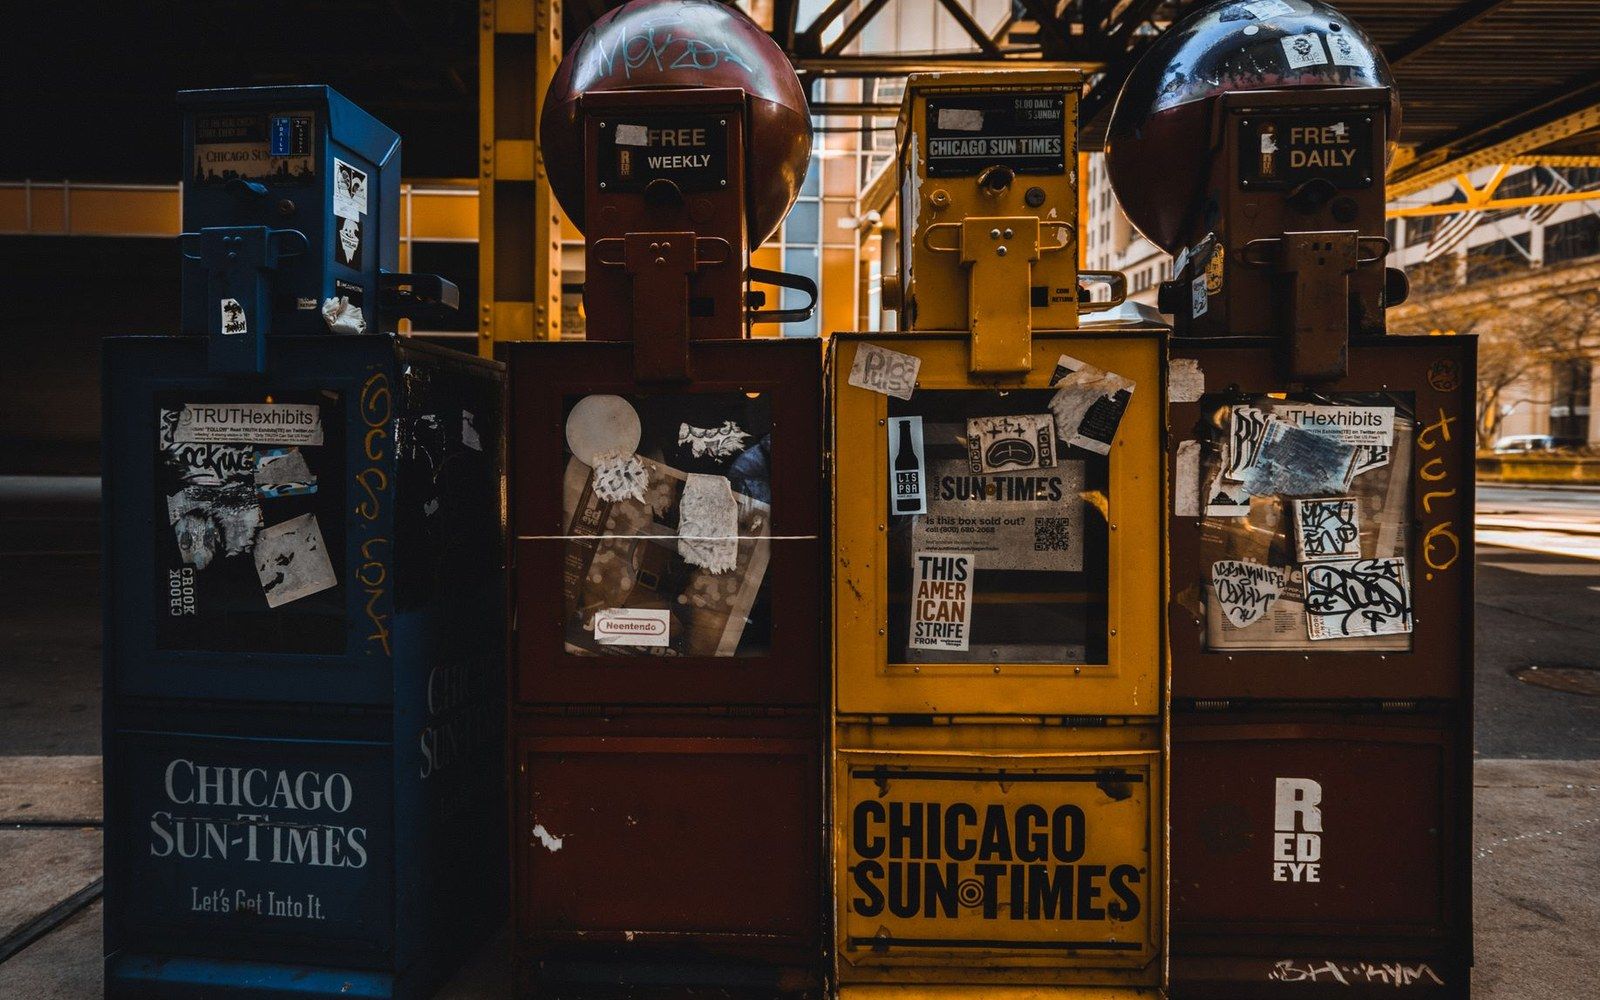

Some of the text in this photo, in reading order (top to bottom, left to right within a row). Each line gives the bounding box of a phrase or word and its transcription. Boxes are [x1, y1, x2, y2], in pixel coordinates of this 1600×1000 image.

[647, 128, 706, 147] FREE
[1290, 126, 1350, 145] FREE
[206, 150, 250, 163] CHICAGO
[929, 138, 1062, 156] CHICAGO SUN TIMES
[647, 154, 711, 171] WEEKLY
[1290, 149, 1357, 168] DAILY
[193, 407, 314, 425] TRUTHexhibits
[1285, 410, 1383, 427] THexhibits
[941, 476, 986, 502] SUN
[992, 475, 1063, 502] TIMES
[926, 516, 1026, 526] Is this box sold out?
[919, 556, 968, 581] THIS
[169, 568, 182, 616] CROOK
[182, 567, 195, 614] CROOK
[917, 581, 966, 600] AMER
[916, 600, 965, 623] ICAN
[606, 621, 657, 632] Neentendo
[915, 622, 963, 639] STRIFE
[914, 637, 938, 645] FROM
[164, 758, 353, 813] CHICAGO
[1275, 777, 1323, 833] R
[150, 811, 368, 868] SUN-TIMES
[852, 800, 1086, 863] CHICAGO
[1275, 832, 1322, 862] ED
[1274, 863, 1321, 883] EYE
[191, 886, 326, 920] Let's Get Into It.
